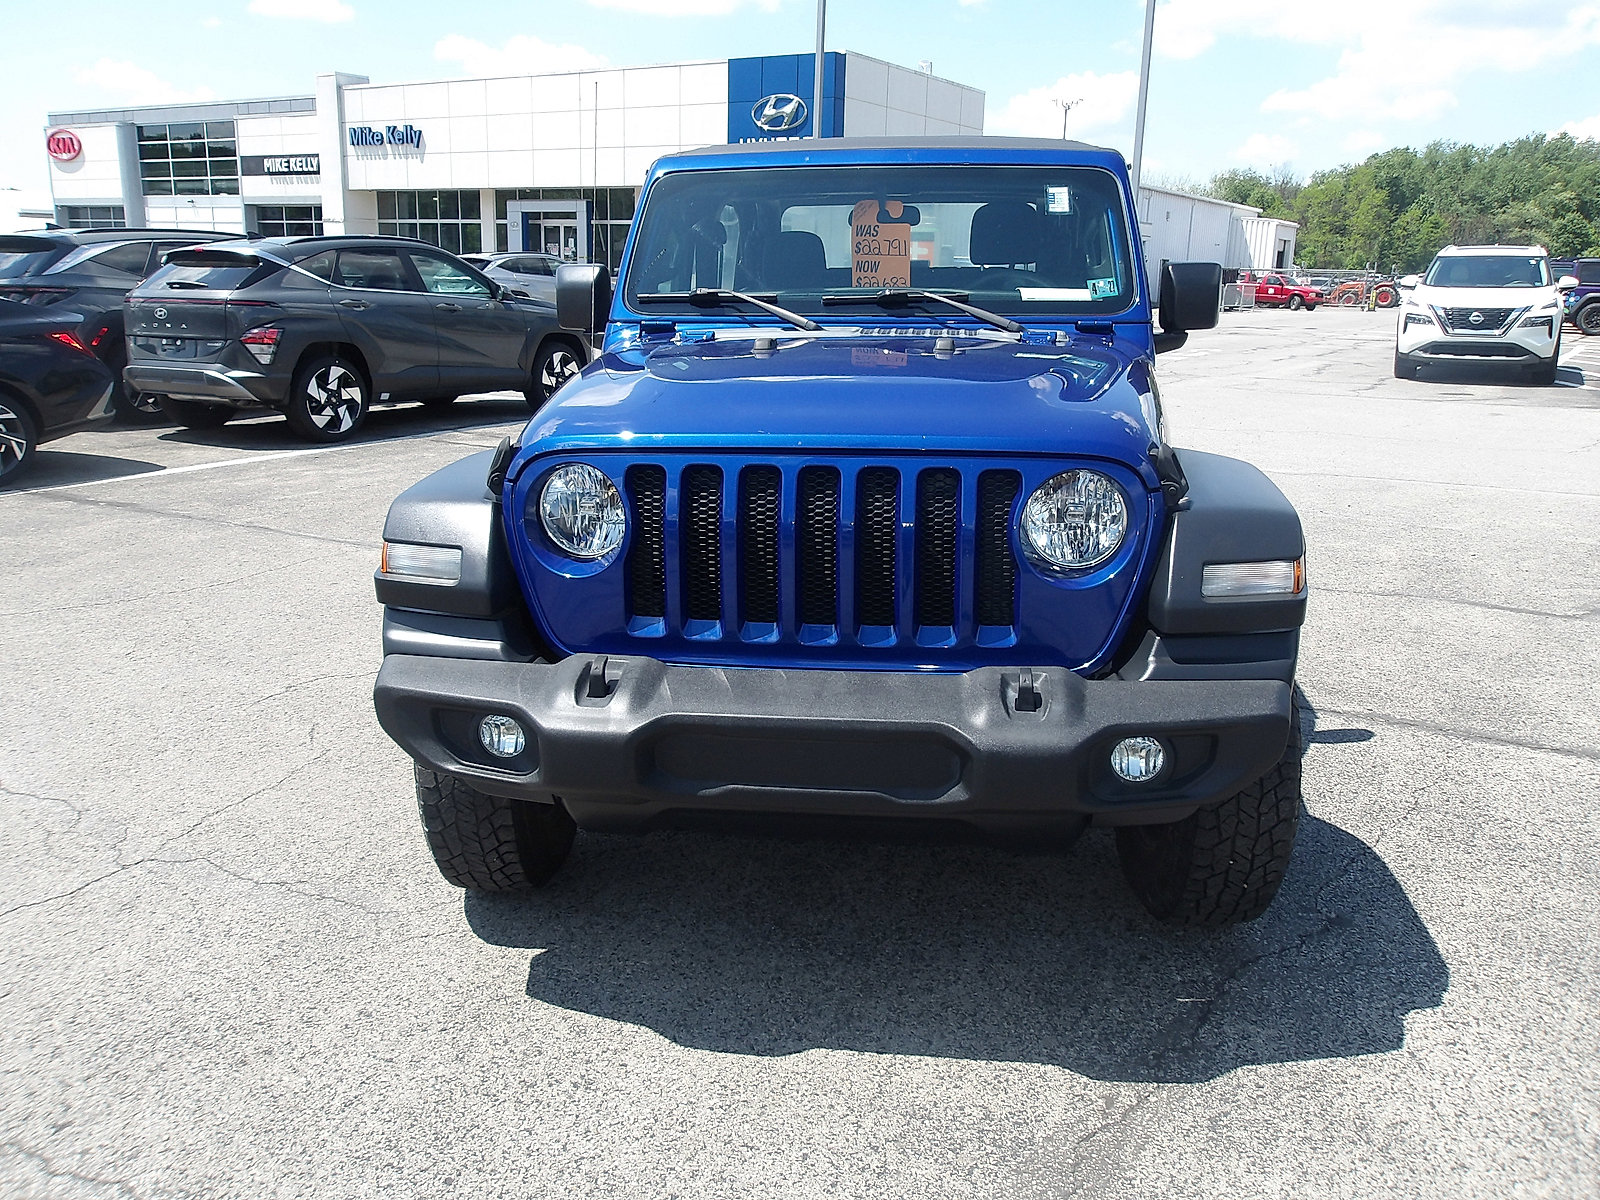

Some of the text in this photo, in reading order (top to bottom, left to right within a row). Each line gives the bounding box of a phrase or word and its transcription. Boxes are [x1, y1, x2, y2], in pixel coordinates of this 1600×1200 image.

[48, 136, 78, 154] KIA
[349, 125, 423, 148] Mike Kelly
[263, 156, 320, 173] MIKE KELLY
[855, 225, 880, 237] WAS
[855, 260, 880, 273] NOW
